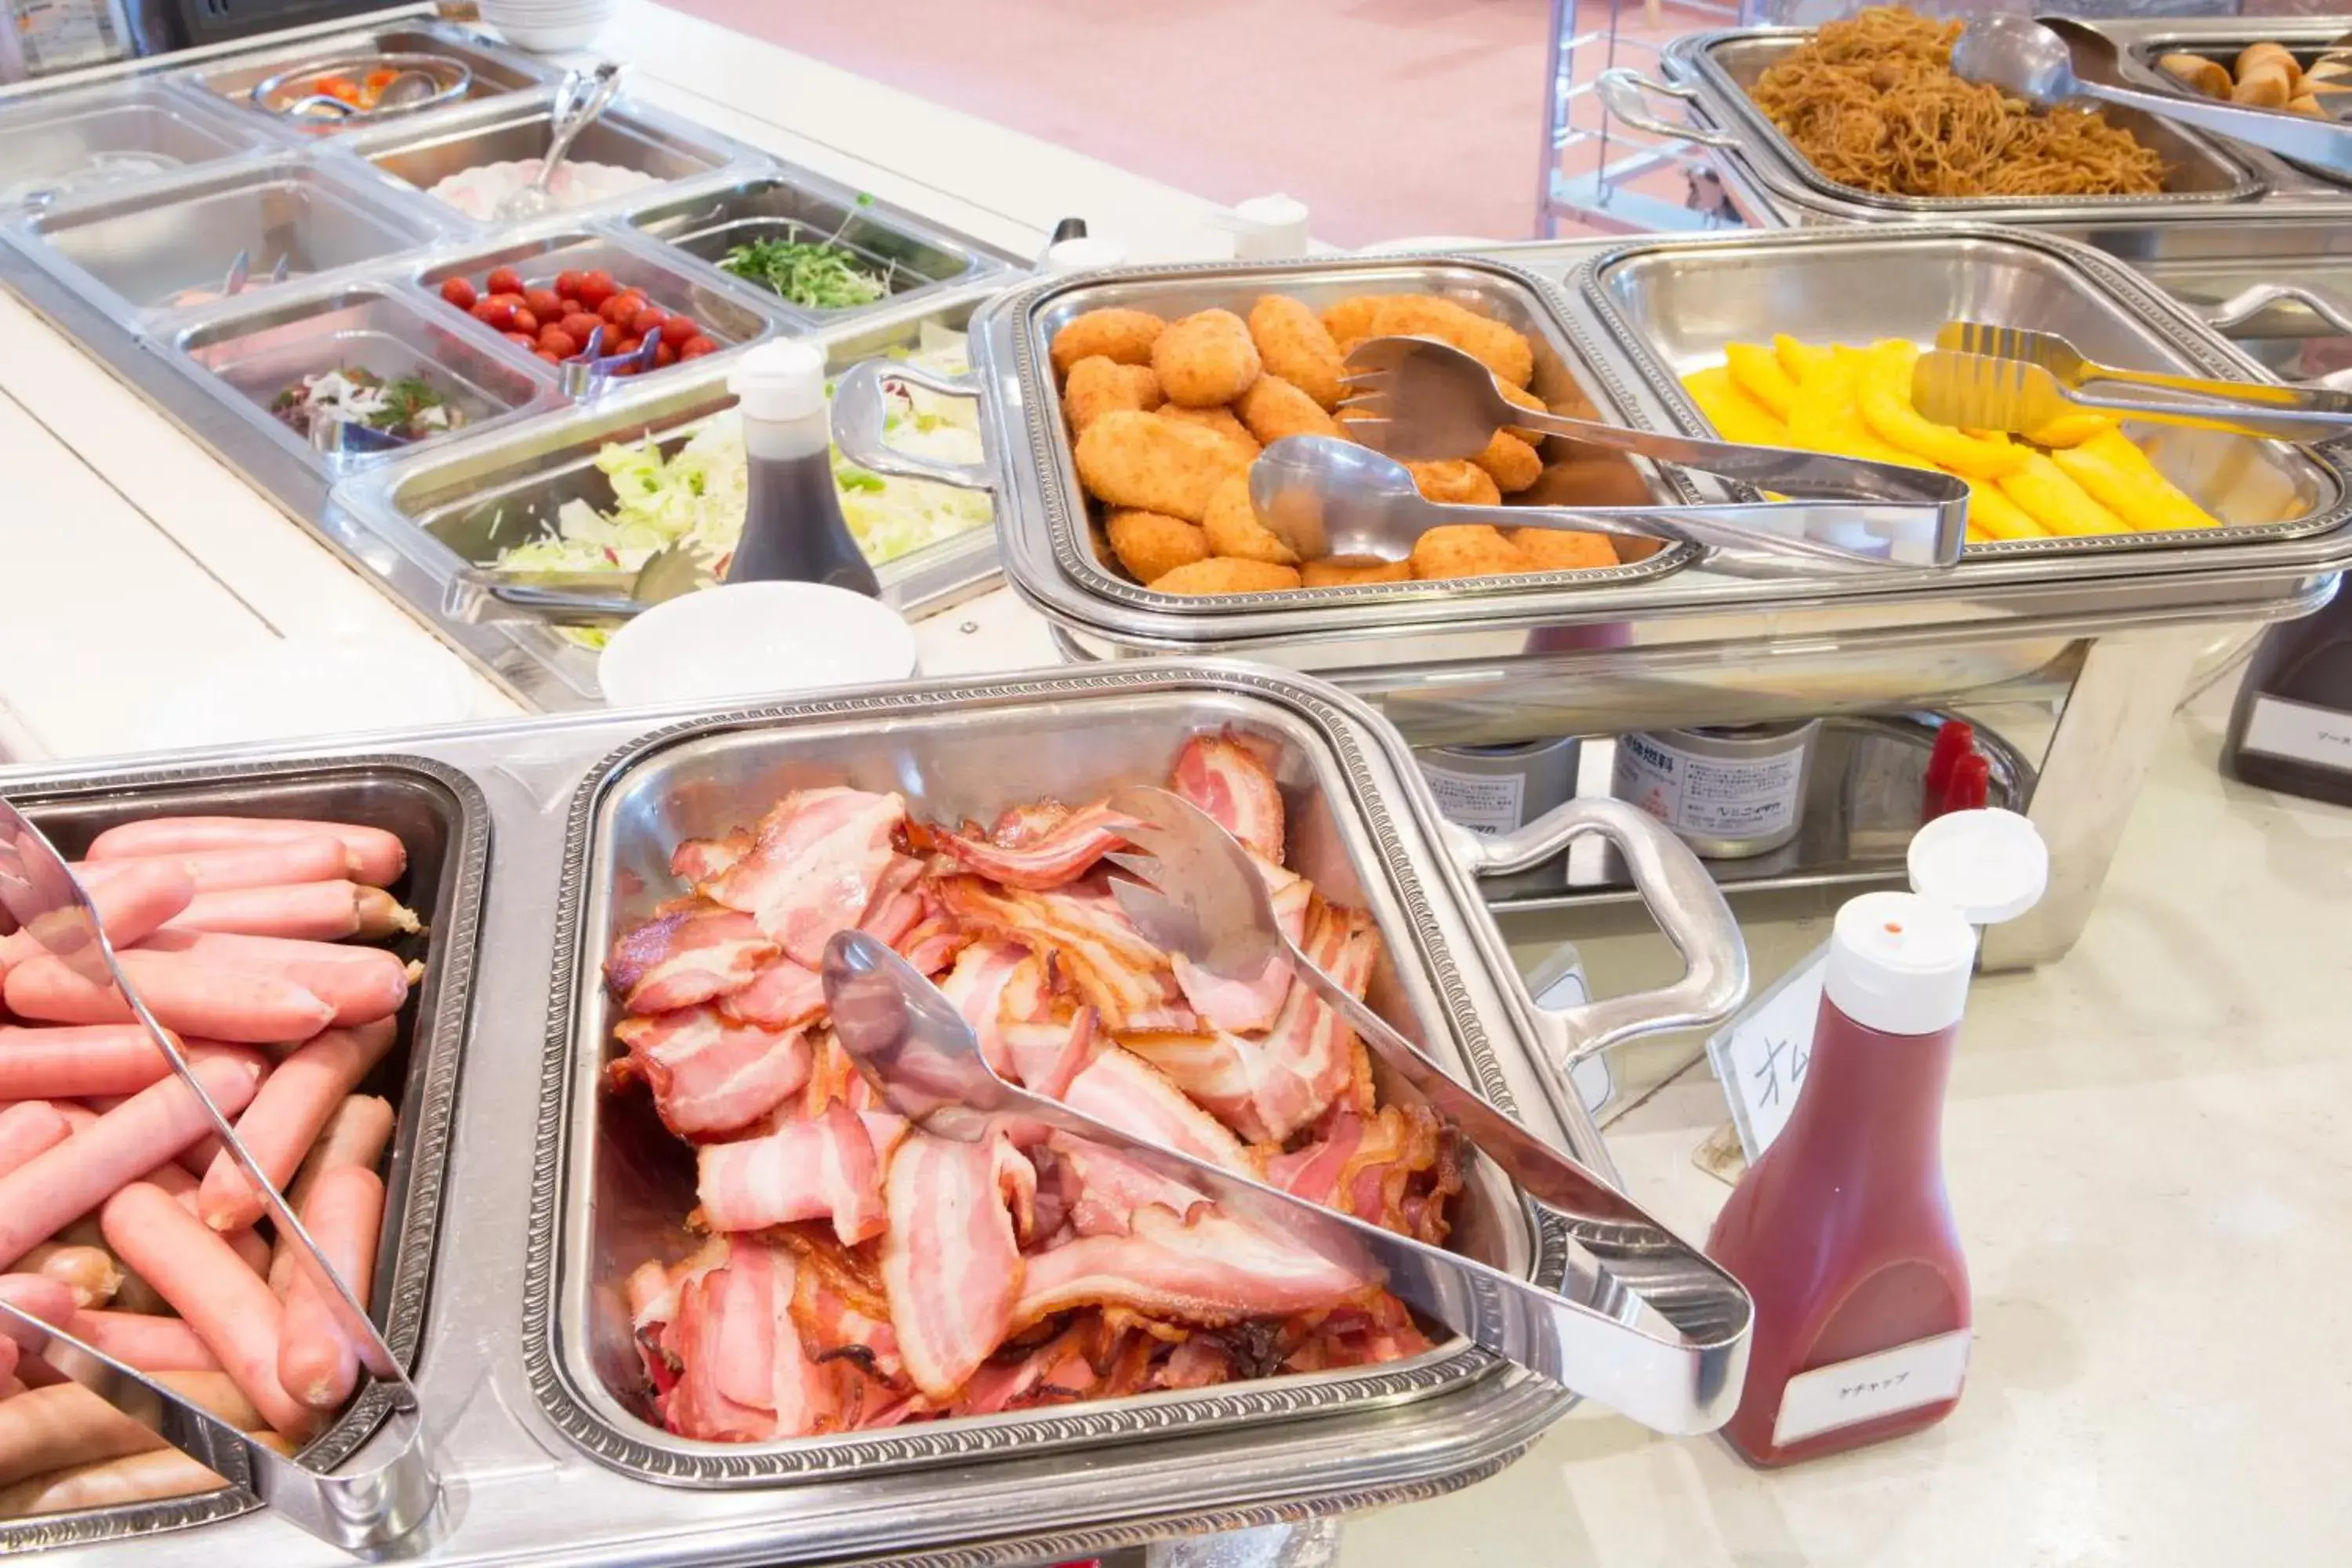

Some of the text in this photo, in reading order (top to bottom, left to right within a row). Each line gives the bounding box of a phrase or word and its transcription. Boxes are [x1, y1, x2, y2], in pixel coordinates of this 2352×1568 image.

[1838, 1370, 1910, 1401] ケチャップ
